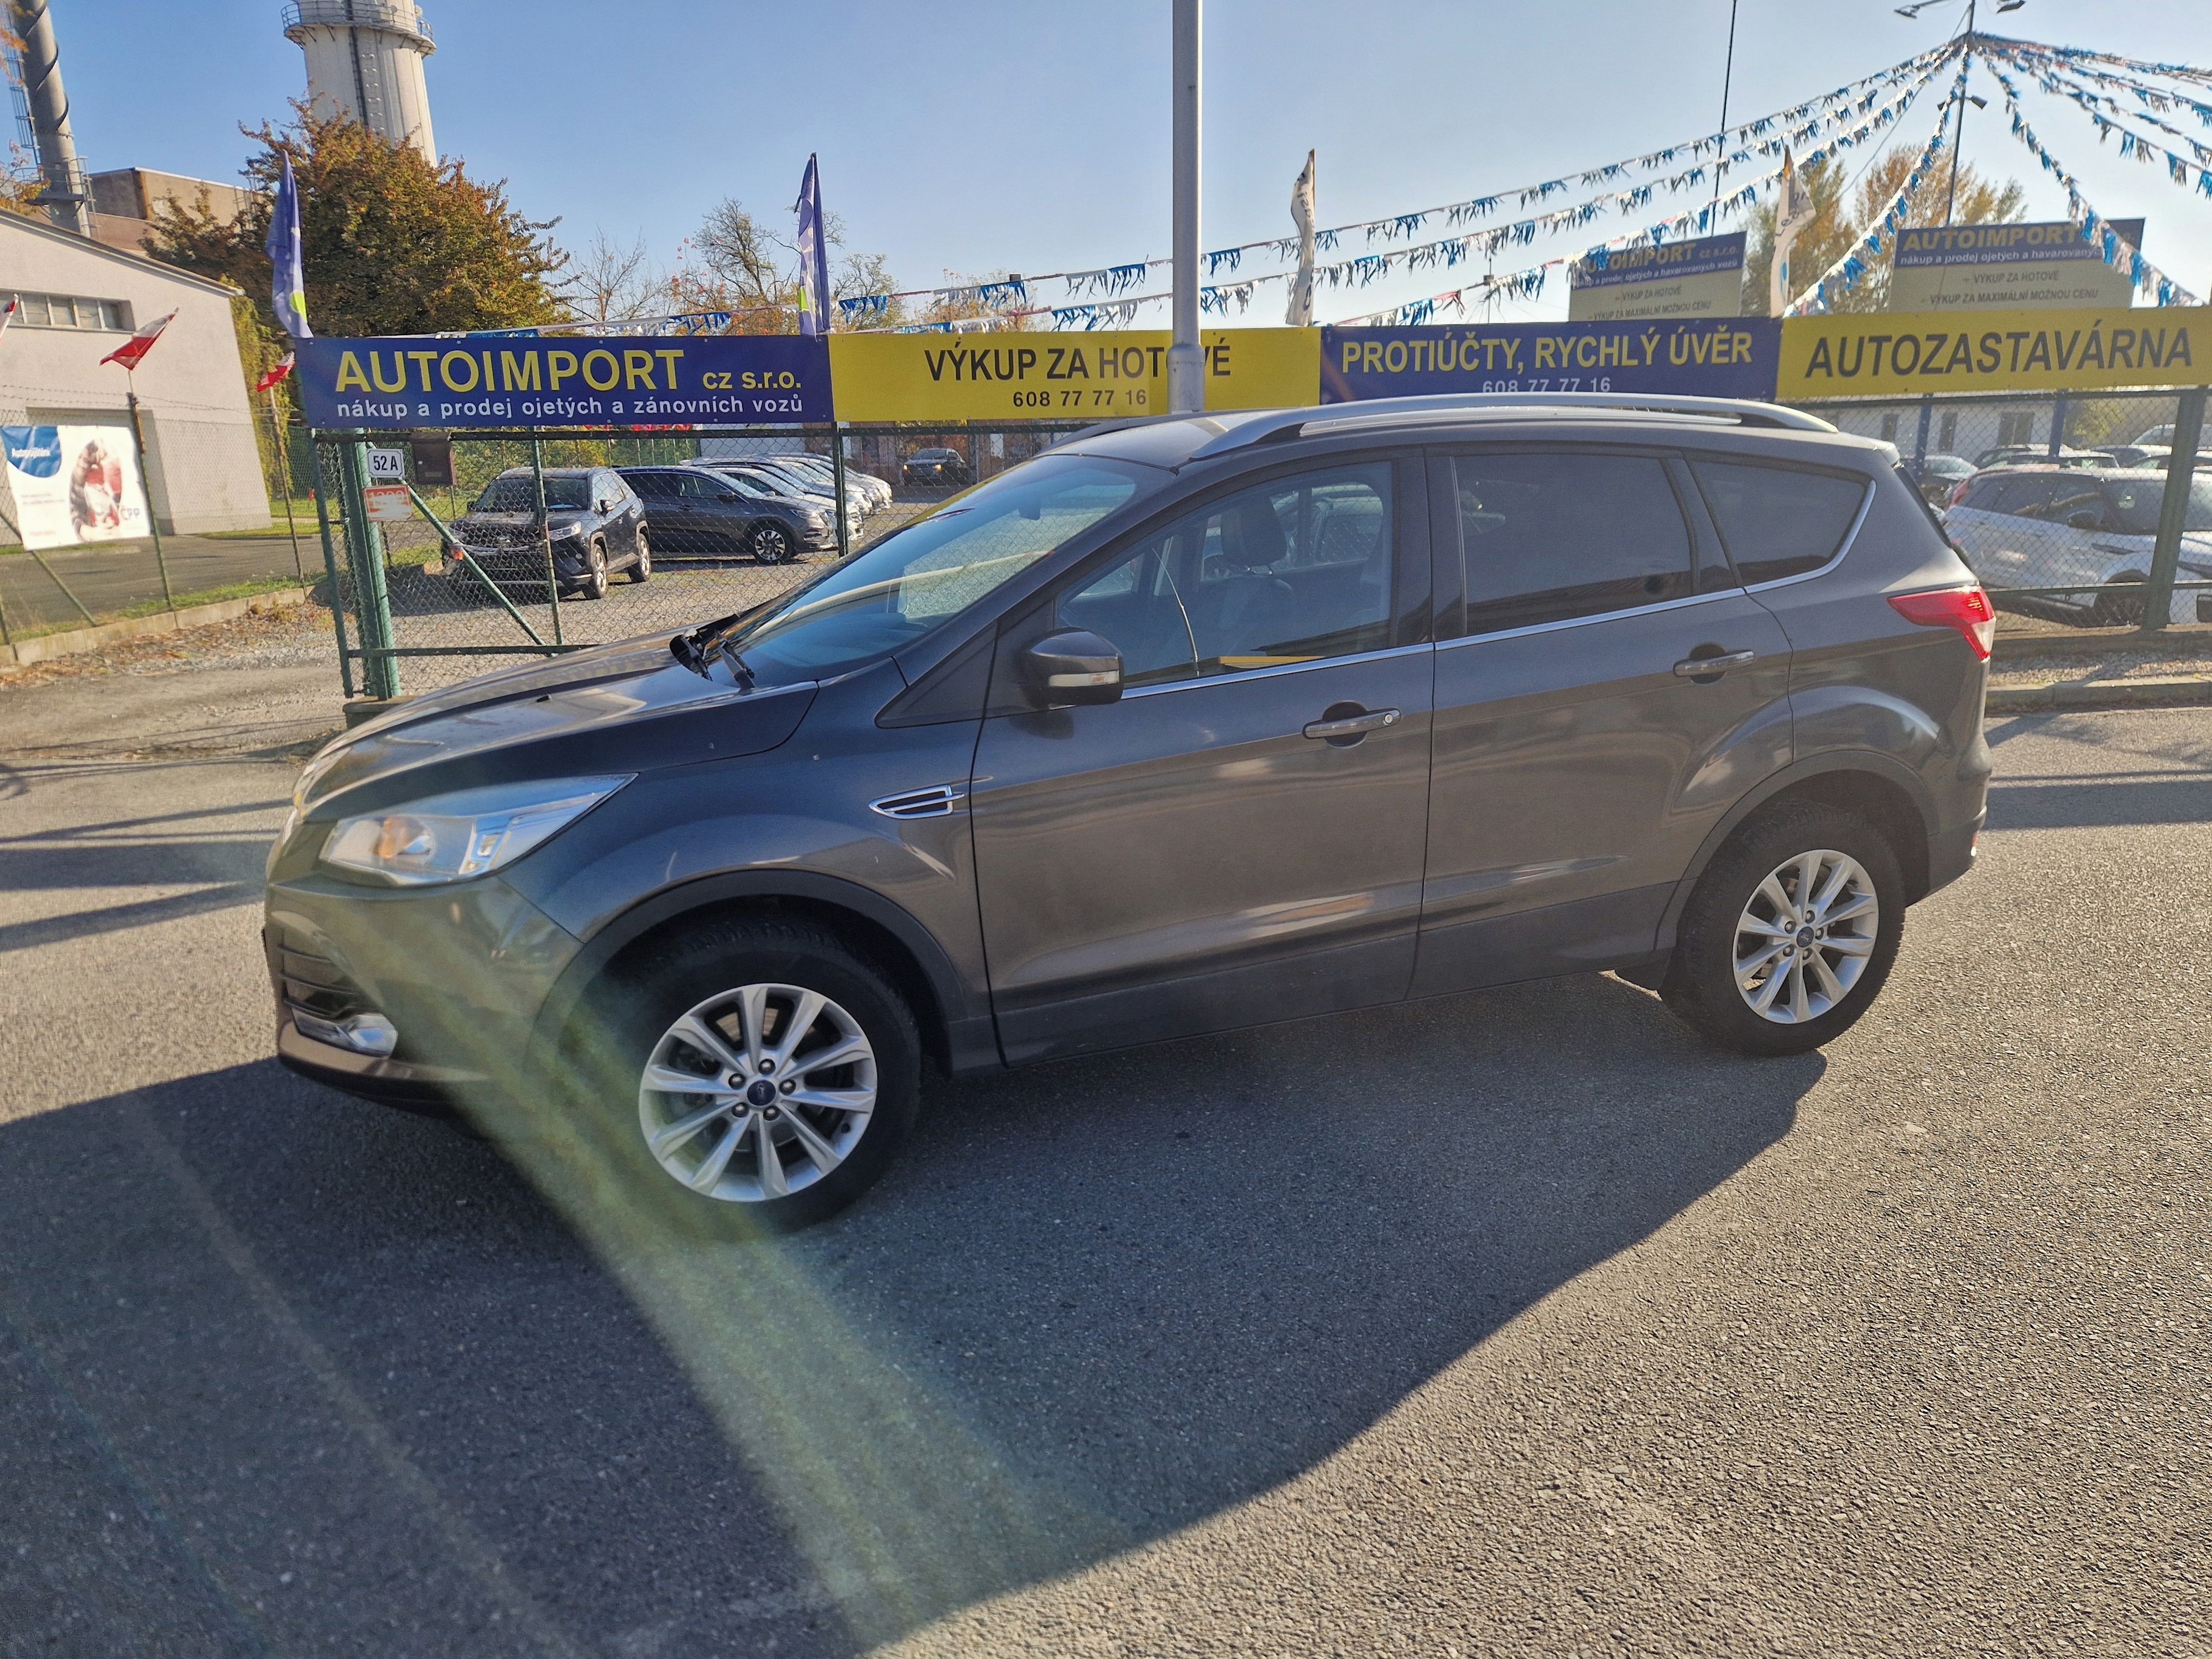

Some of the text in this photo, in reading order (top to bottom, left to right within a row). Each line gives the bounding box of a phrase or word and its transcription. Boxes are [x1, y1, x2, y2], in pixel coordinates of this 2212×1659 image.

[1902, 224, 2081, 252] AUTOIMPORT
[1582, 243, 1697, 273] UOIMPORT
[1900, 254, 1933, 265] nákup
[1944, 252, 1978, 264] prodej
[1981, 250, 2019, 262] ojetých
[2006, 272, 2018, 282] ZA
[1963, 293, 1975, 304] ZA
[925, 337, 1231, 382] VÝKUP ZA HOTÉ
[1342, 325, 1753, 375] PROTIÚČTY, RYCHLÝ ÚVĚR
[1804, 320, 2193, 379] AUTOZASTAVÁRNA
[335, 348, 802, 392] AUTOIMPORT cz s.r.o.
[1013, 389, 1146, 408] 608 77 77 16
[1482, 377, 1611, 393] 608 77 77 16
[338, 392, 804, 420] nákup a prodej ojetých a zánovních vozů
